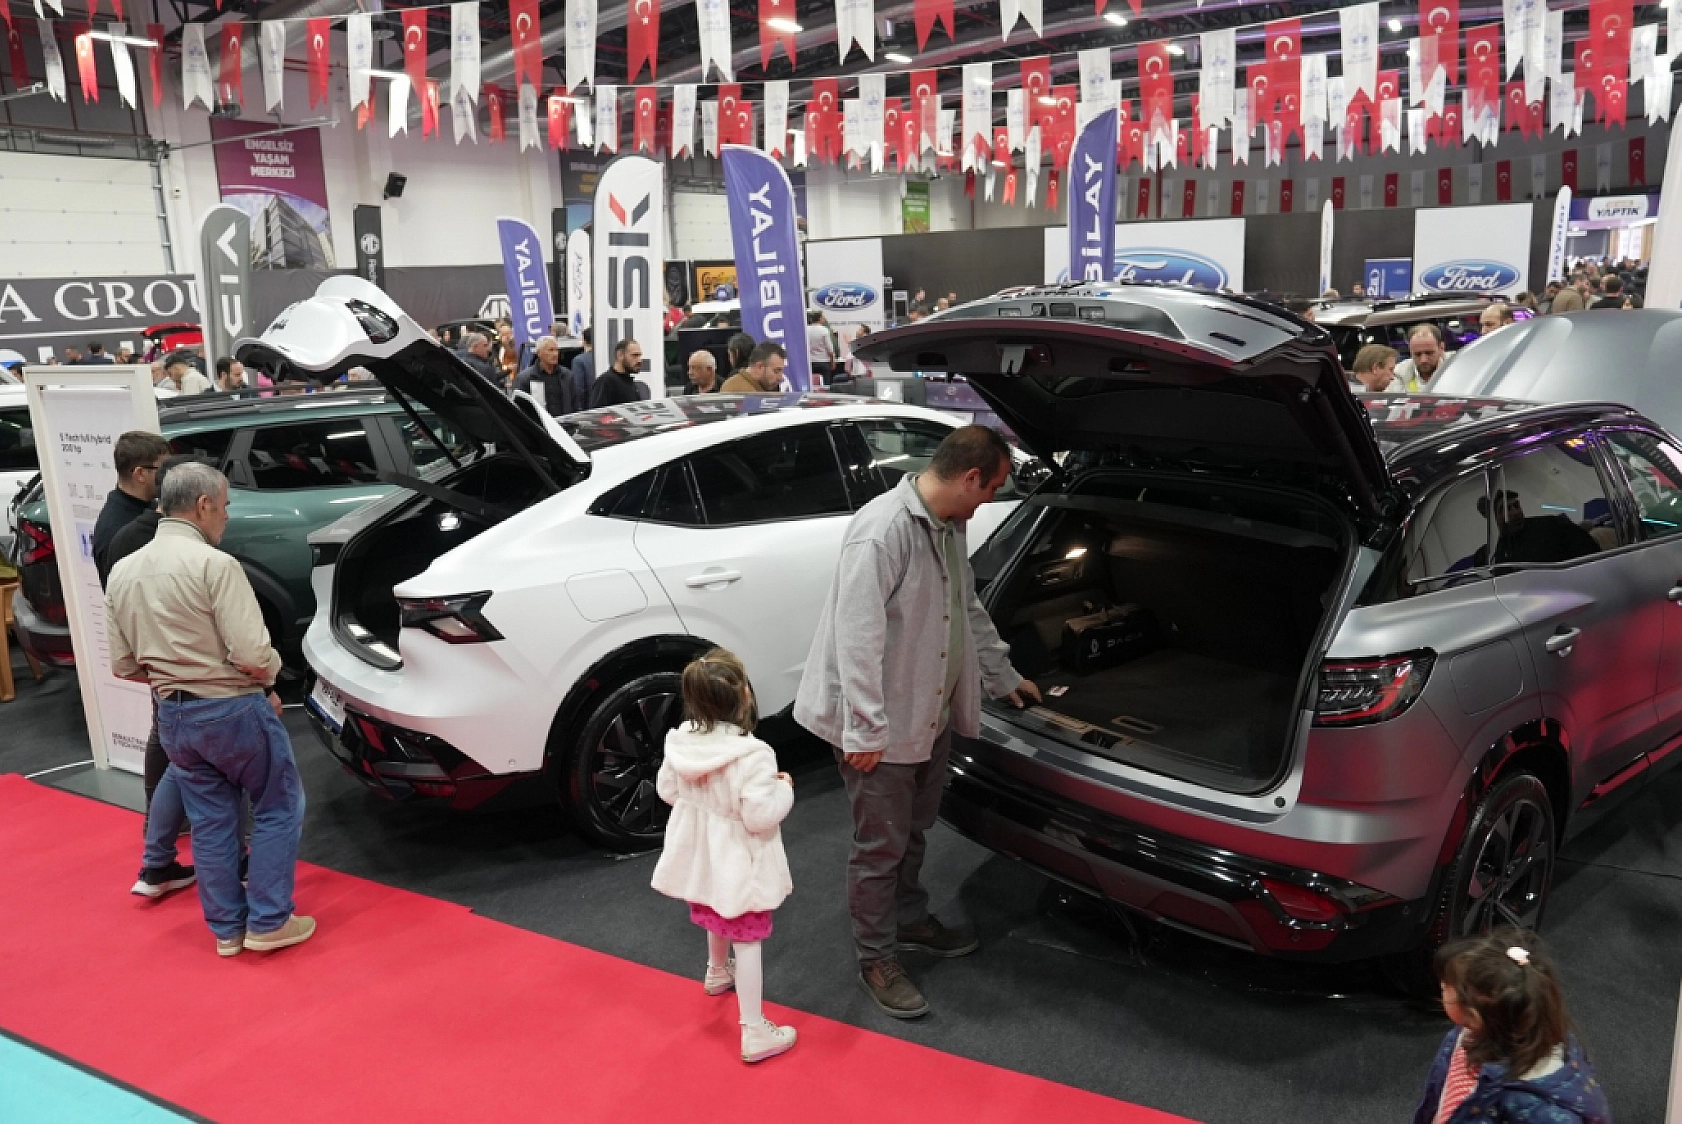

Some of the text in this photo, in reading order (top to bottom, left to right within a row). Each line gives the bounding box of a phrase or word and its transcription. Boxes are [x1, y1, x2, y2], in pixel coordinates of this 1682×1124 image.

[244, 138, 295, 152] ENGELSİZ
[252, 152, 290, 165] YAŞAM
[249, 165, 295, 178] MERKEZİ
[1081, 152, 1103, 282] BİLAY
[0, 279, 202, 324] A GROU
[607, 191, 651, 400] FSK
